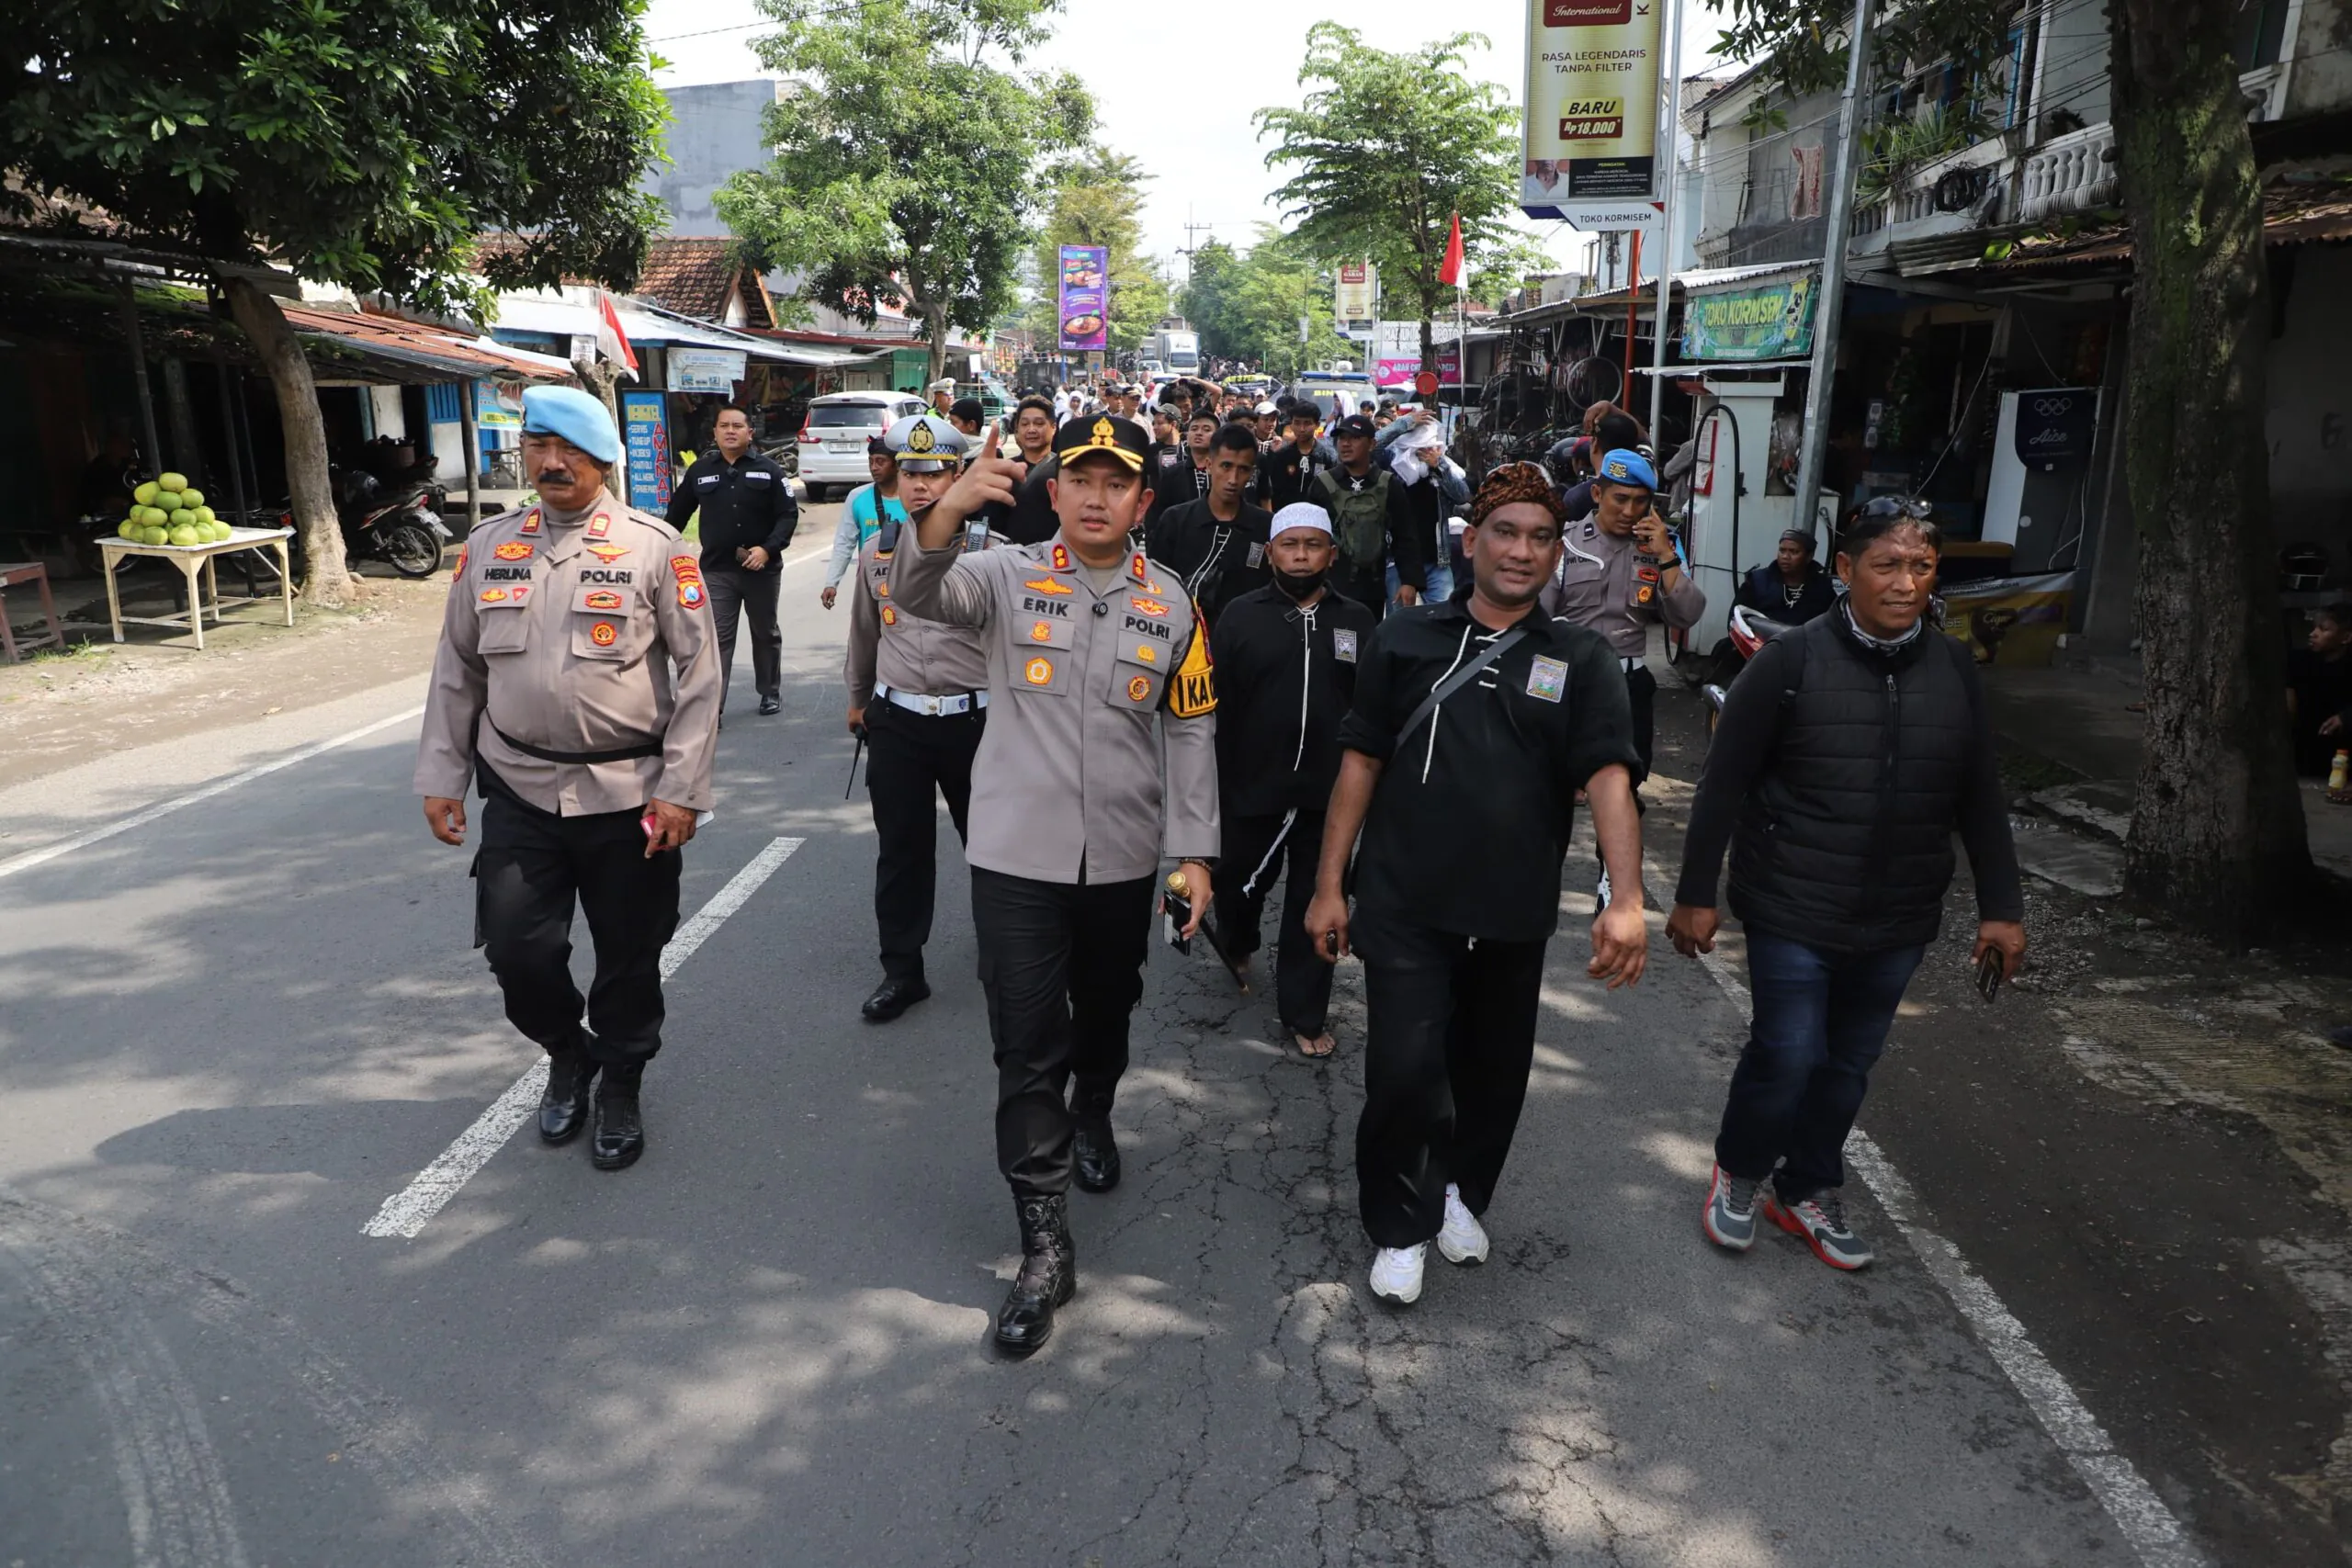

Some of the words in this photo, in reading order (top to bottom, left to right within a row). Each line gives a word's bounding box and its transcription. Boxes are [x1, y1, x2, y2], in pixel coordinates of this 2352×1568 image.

[1552, 3, 1622, 17] International
[1542, 52, 1572, 62] RASA
[1575, 49, 1646, 61] LEGENDARIS
[1555, 64, 1592, 73] TANPA
[1596, 62, 1633, 73] FILTER
[1568, 100, 1617, 115] BARU
[1580, 215, 1602, 223] TOKO
[1604, 213, 1652, 222] KORMISEM
[1704, 301, 1727, 327] TOKO
[652, 422, 671, 505] AMANAH
[581, 570, 632, 583] POLRI
[1023, 597, 1069, 617] ERIK
[1125, 615, 1170, 640] POLRI
